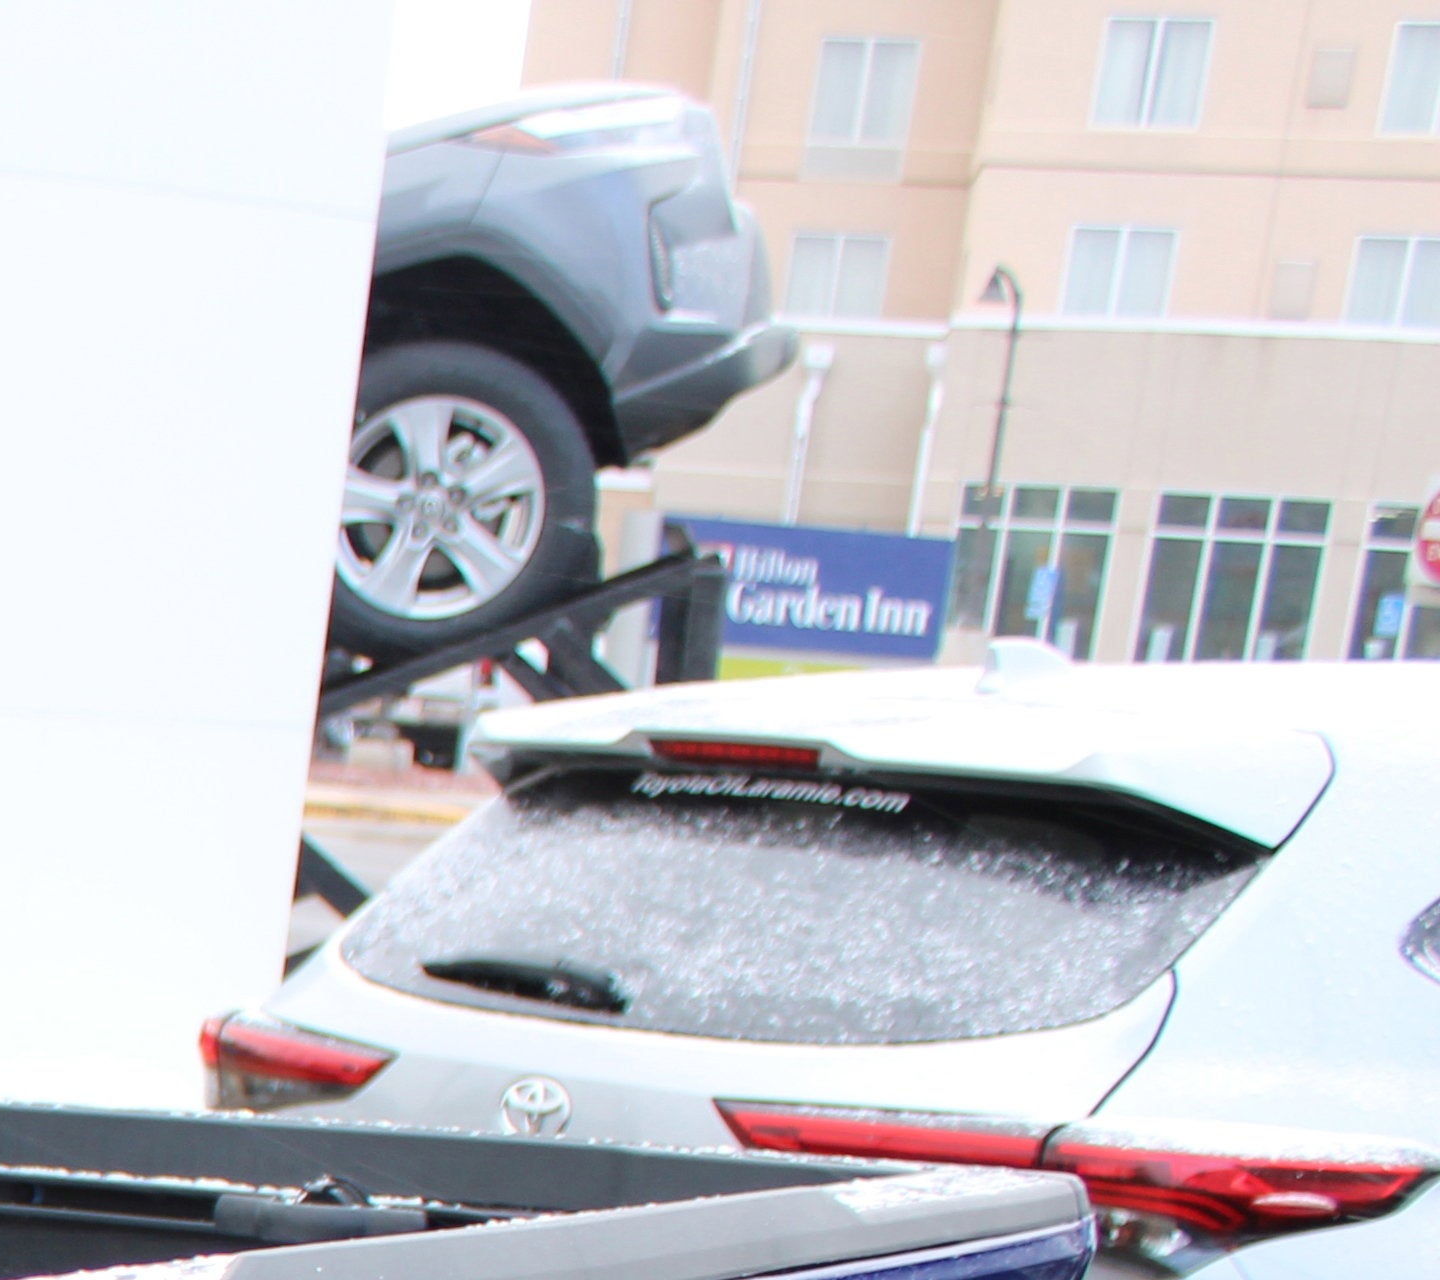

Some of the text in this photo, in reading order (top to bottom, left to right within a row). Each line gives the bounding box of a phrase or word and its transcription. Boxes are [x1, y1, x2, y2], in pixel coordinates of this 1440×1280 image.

[733, 546, 819, 585] Hilton
[727, 582, 931, 637] Garden Inn
[632, 770, 911, 814] ToyotaOfLaramie.com
